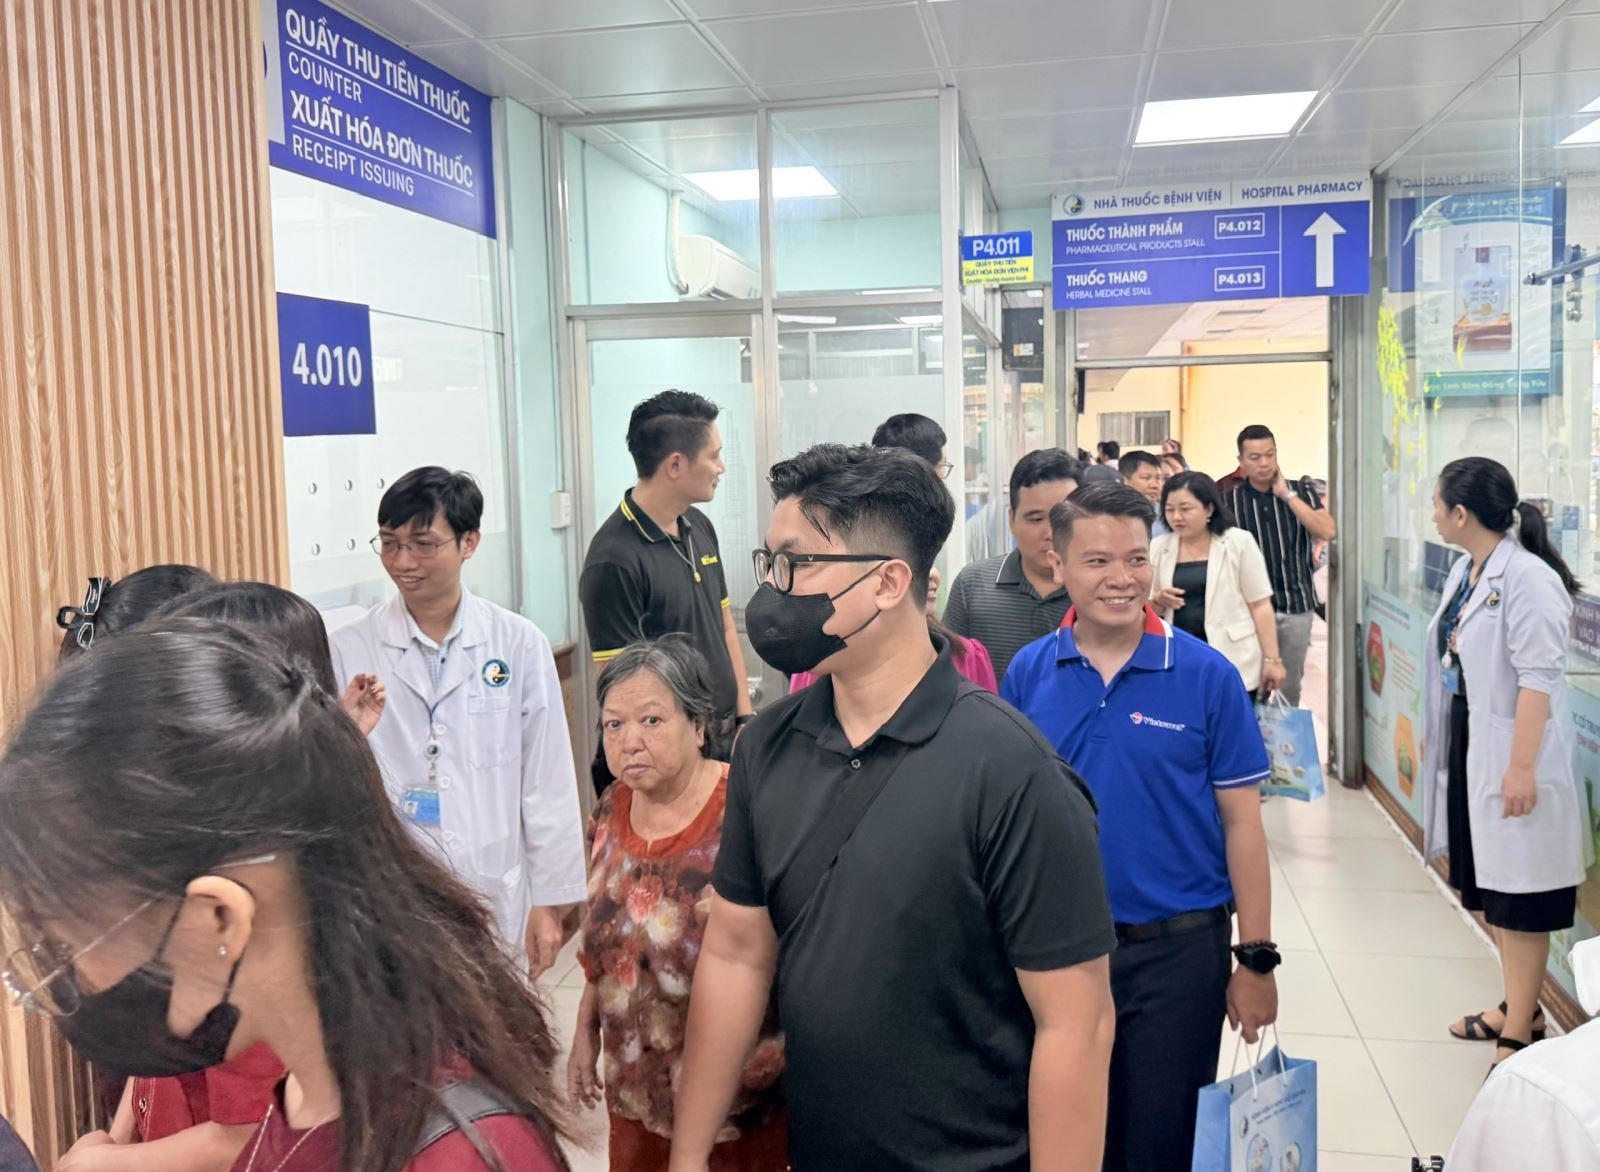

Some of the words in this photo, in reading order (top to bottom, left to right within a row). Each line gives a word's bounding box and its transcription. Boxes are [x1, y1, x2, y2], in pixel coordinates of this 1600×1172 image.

[286, 8, 339, 58] QUẦY
[343, 38, 380, 79] THU
[382, 58, 419, 100] TIỀN
[420, 78, 470, 124] THUỐC
[288, 52, 362, 104] COUNTER
[290, 90, 342, 136] XUẤT
[346, 114, 385, 154] HÓA
[386, 131, 422, 169] ĐƠN
[424, 148, 473, 188] THUỐC
[292, 134, 356, 175] RECEIPT
[360, 159, 414, 196] ISSUING
[1094, 196, 1118, 209] NHÀ
[1122, 191, 1160, 207] THUỐC
[1164, 190, 1192, 208] BỆNH
[1196, 188, 1222, 205] VIỆN
[1242, 186, 1294, 200] HOSPITAL
[1297, 181, 1363, 195] PHARMACY
[1066, 224, 1105, 242] THUỐC
[1108, 222, 1146, 240] THÀNH
[1150, 217, 1183, 236] PHẨM
[1218, 220, 1261, 233] P4.012
[972, 236, 1020, 257] P4.011
[1066, 243, 1137, 256] PHARMACEUTICAL
[1140, 240, 1182, 250] PRODUCTS
[1184, 238, 1205, 248] STALL
[1066, 269, 1105, 287] THUỐC
[1108, 270, 1148, 284] THANG
[1218, 272, 1261, 285] P4.013
[1066, 290, 1094, 300] HERBAL
[1094, 287, 1131, 298] MEDICINE
[1132, 286, 1152, 296] STALL
[292, 342, 362, 387] 4.010
